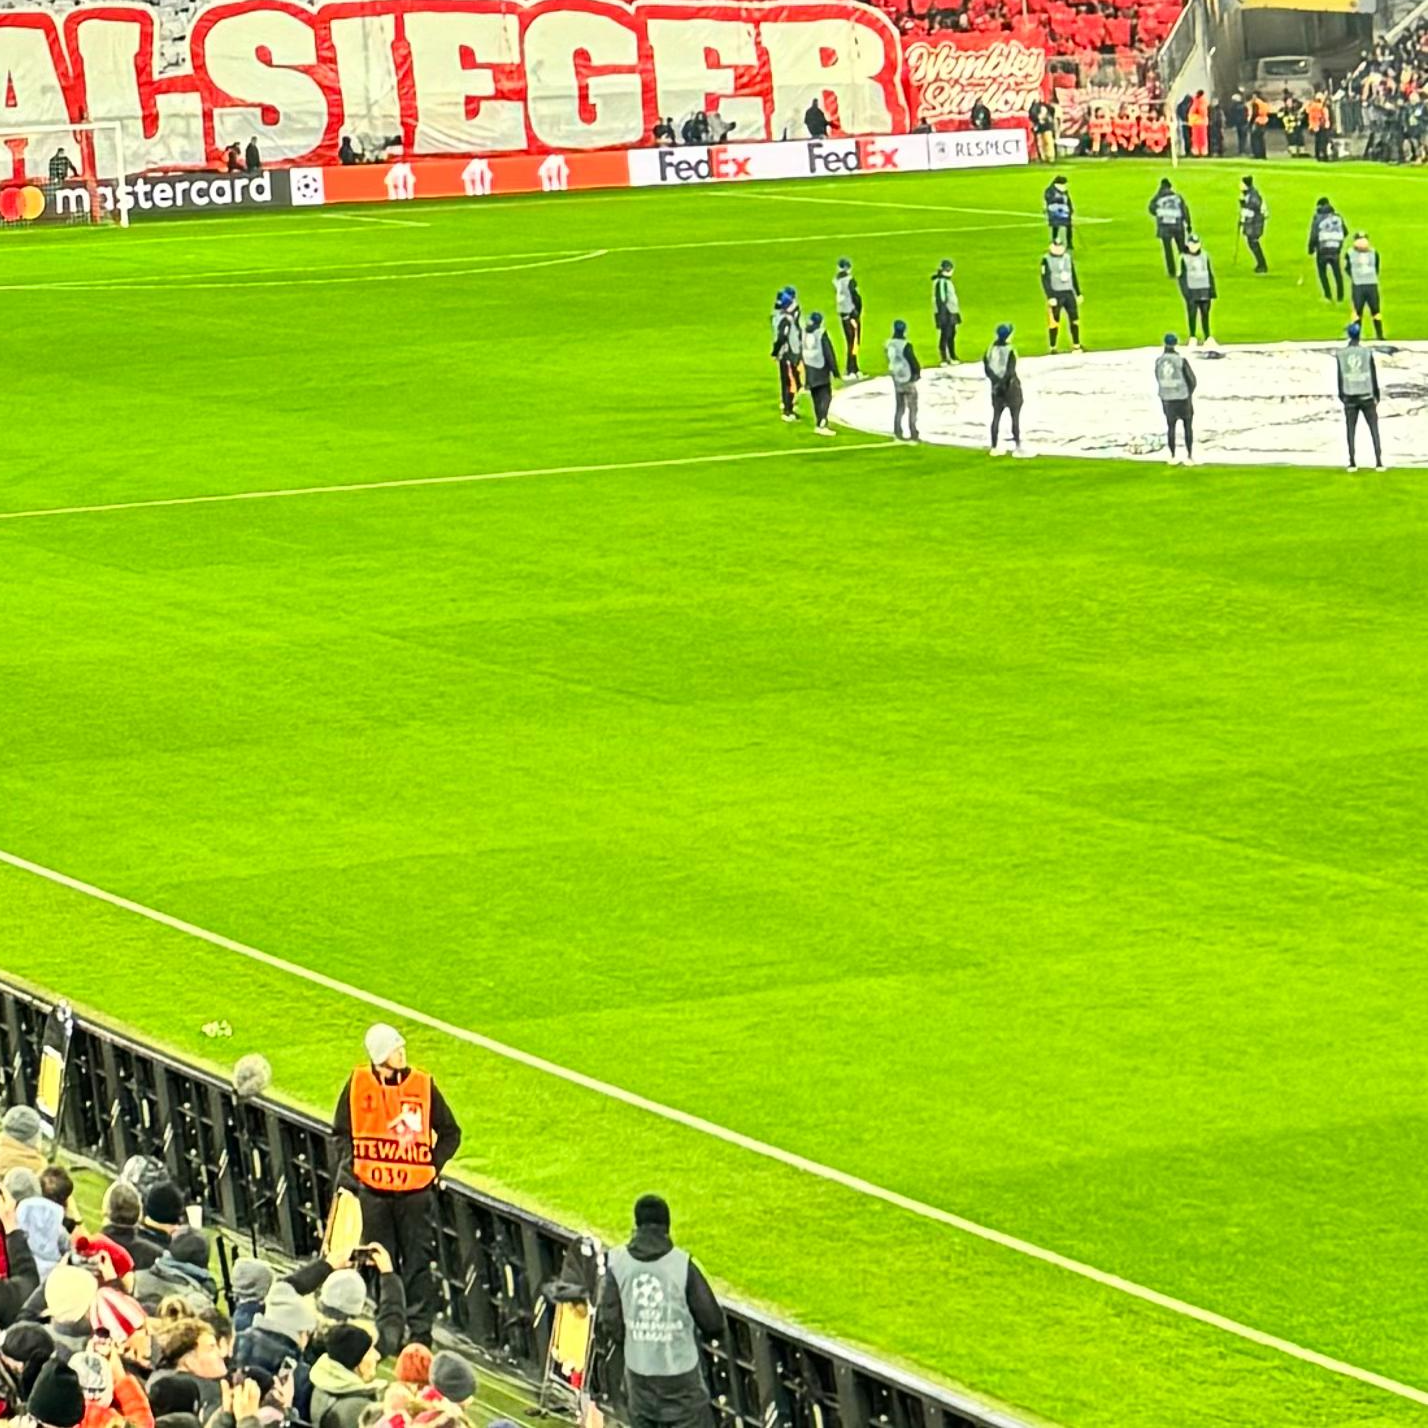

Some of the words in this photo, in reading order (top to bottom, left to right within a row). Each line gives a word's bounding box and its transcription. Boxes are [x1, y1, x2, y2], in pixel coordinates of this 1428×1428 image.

[908, 41, 1046, 88] Wembley
[658, 148, 752, 181] FedEx
[807, 140, 899, 174] FedEx
[954, 138, 1022, 158] RESPECT
